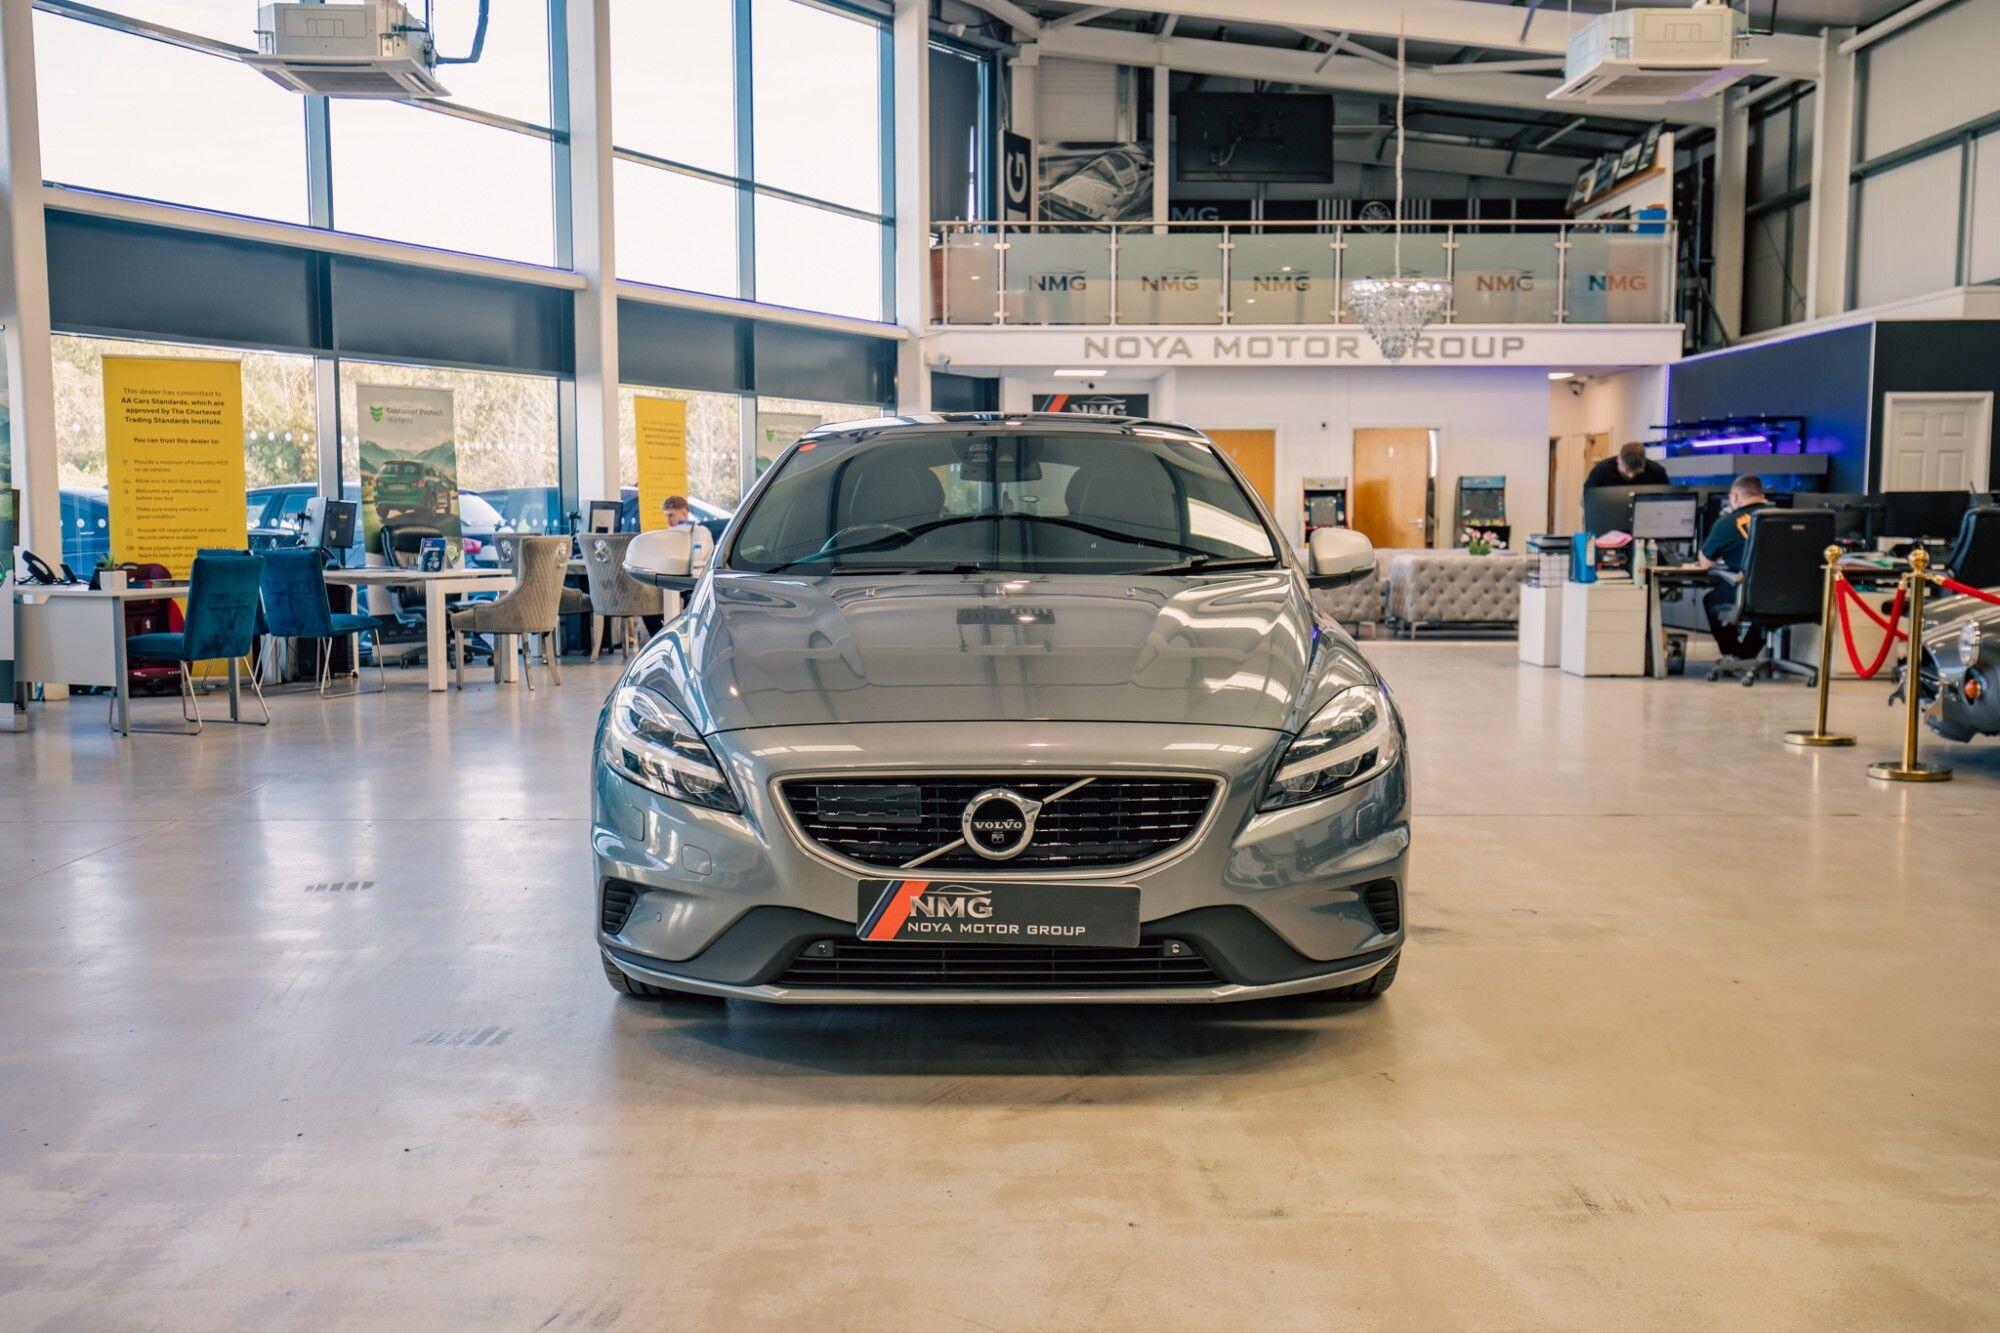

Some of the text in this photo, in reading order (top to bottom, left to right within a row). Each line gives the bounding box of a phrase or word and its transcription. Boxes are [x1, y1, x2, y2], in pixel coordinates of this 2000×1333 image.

[1029, 276, 1087, 291] NMG
[1142, 276, 1199, 291] NMG
[1254, 276, 1311, 291] NMG
[1476, 275, 1534, 291] NMG
[1589, 274, 1646, 291] NMG
[1084, 337, 1193, 358] NOYA
[1214, 337, 1359, 358] MOTOR
[162, 388, 175, 396] has
[176, 389, 214, 397] committed
[132, 397, 150, 405] Cars
[125, 407, 160, 415] approved
[161, 407, 170, 415] by
[185, 408, 221, 416] Chartered
[386, 407, 443, 417] Customer Protect
[125, 416, 153, 424] Trading
[153, 417, 190, 425] Standards
[973, 821, 1023, 829] VOLVO
[909, 895, 993, 919] NMG
[907, 922, 1086, 936] NOYA MOTOR GROUP
